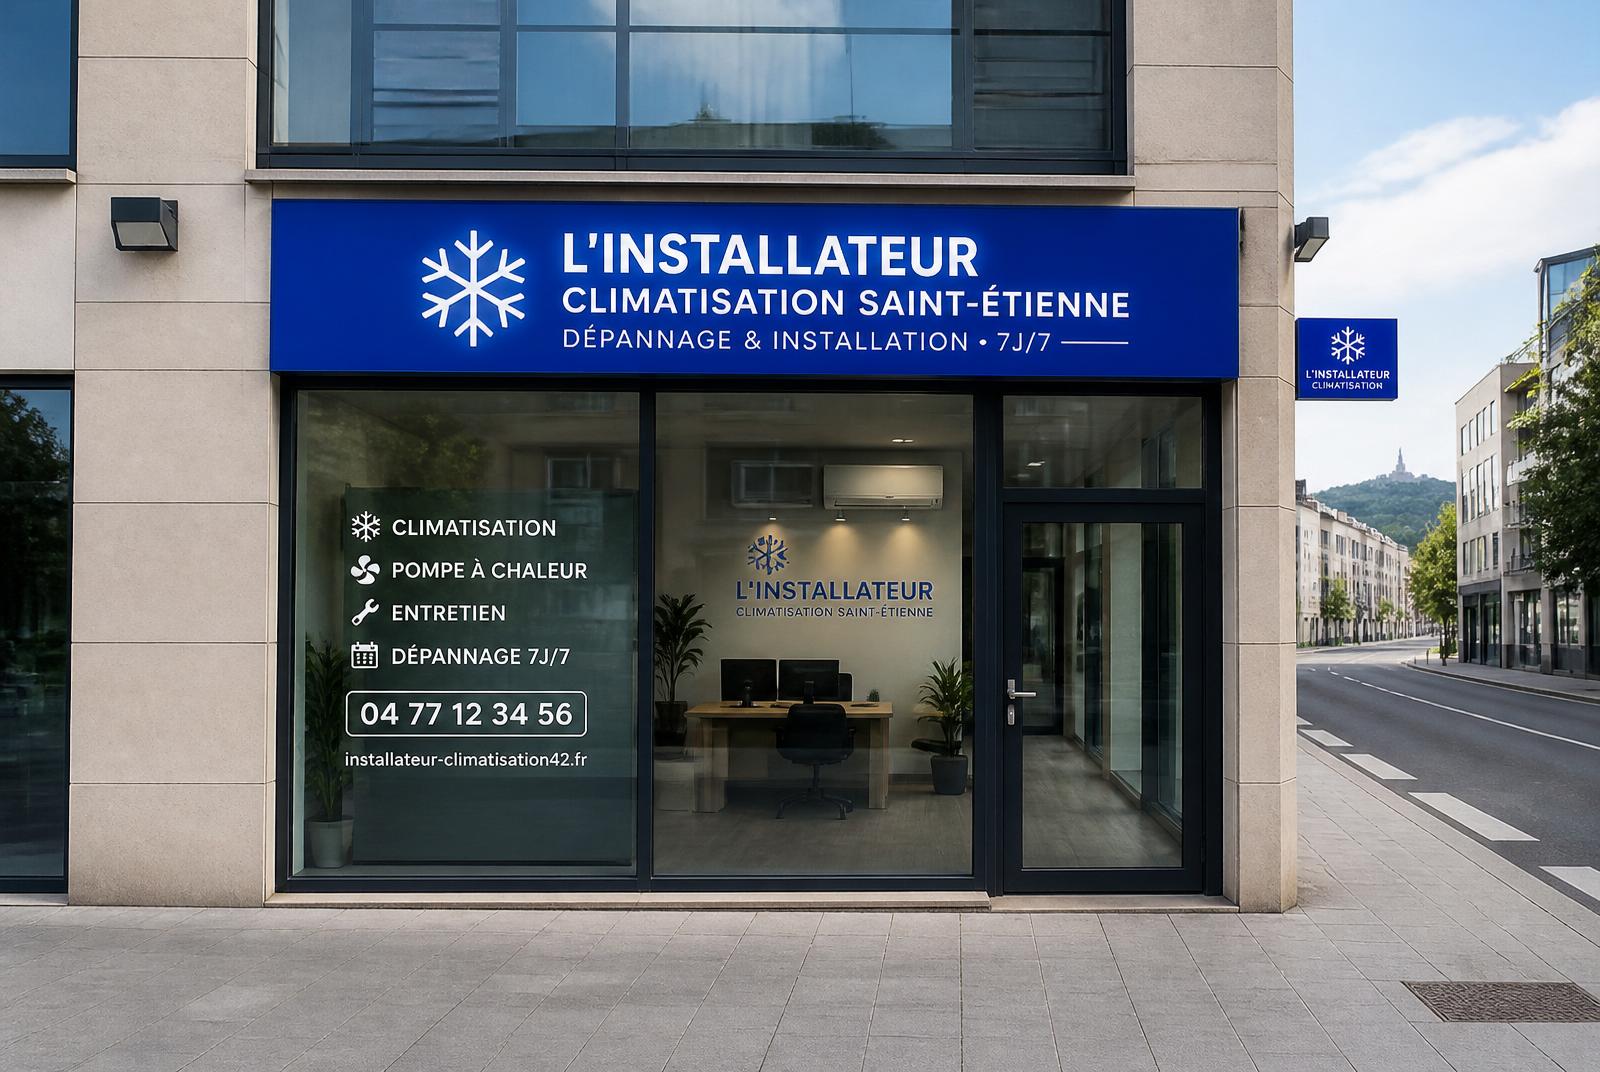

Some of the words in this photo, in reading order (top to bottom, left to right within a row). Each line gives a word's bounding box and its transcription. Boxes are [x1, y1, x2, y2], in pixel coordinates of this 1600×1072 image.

[563, 232, 979, 278] L'INSTALLATEUR
[562, 286, 845, 316] CLIMATISATION
[858, 284, 1130, 318] SAINT-ÉTIENNE
[563, 323, 731, 351] DÉPANNAGE
[744, 330, 761, 351] &
[773, 330, 967, 352] INSTALLATION
[997, 332, 1051, 354] 7J/7
[1305, 369, 1390, 379] L'INSTALLATEUR
[1311, 381, 1383, 390] CLIMATISATION
[392, 519, 556, 537] CLIMATISATION
[392, 561, 465, 579] POMPE
[470, 558, 486, 579] À
[491, 562, 588, 580] CHALEUR
[735, 580, 934, 601] L'INSTALLATEUR
[392, 604, 506, 622] ENTRETIEN
[735, 606, 833, 618] CLIMATISATION
[838, 604, 934, 618] SAINT-ÉTIENNE
[392, 643, 521, 665] DÉPANNAGE
[527, 647, 571, 667] 7J/7
[360, 702, 399, 726] 04
[408, 702, 442, 726] 77
[452, 702, 482, 726] 12
[491, 702, 529, 726] 34
[538, 702, 573, 726] 56
[344, 751, 588, 768] installateur-climatisation42.fr
